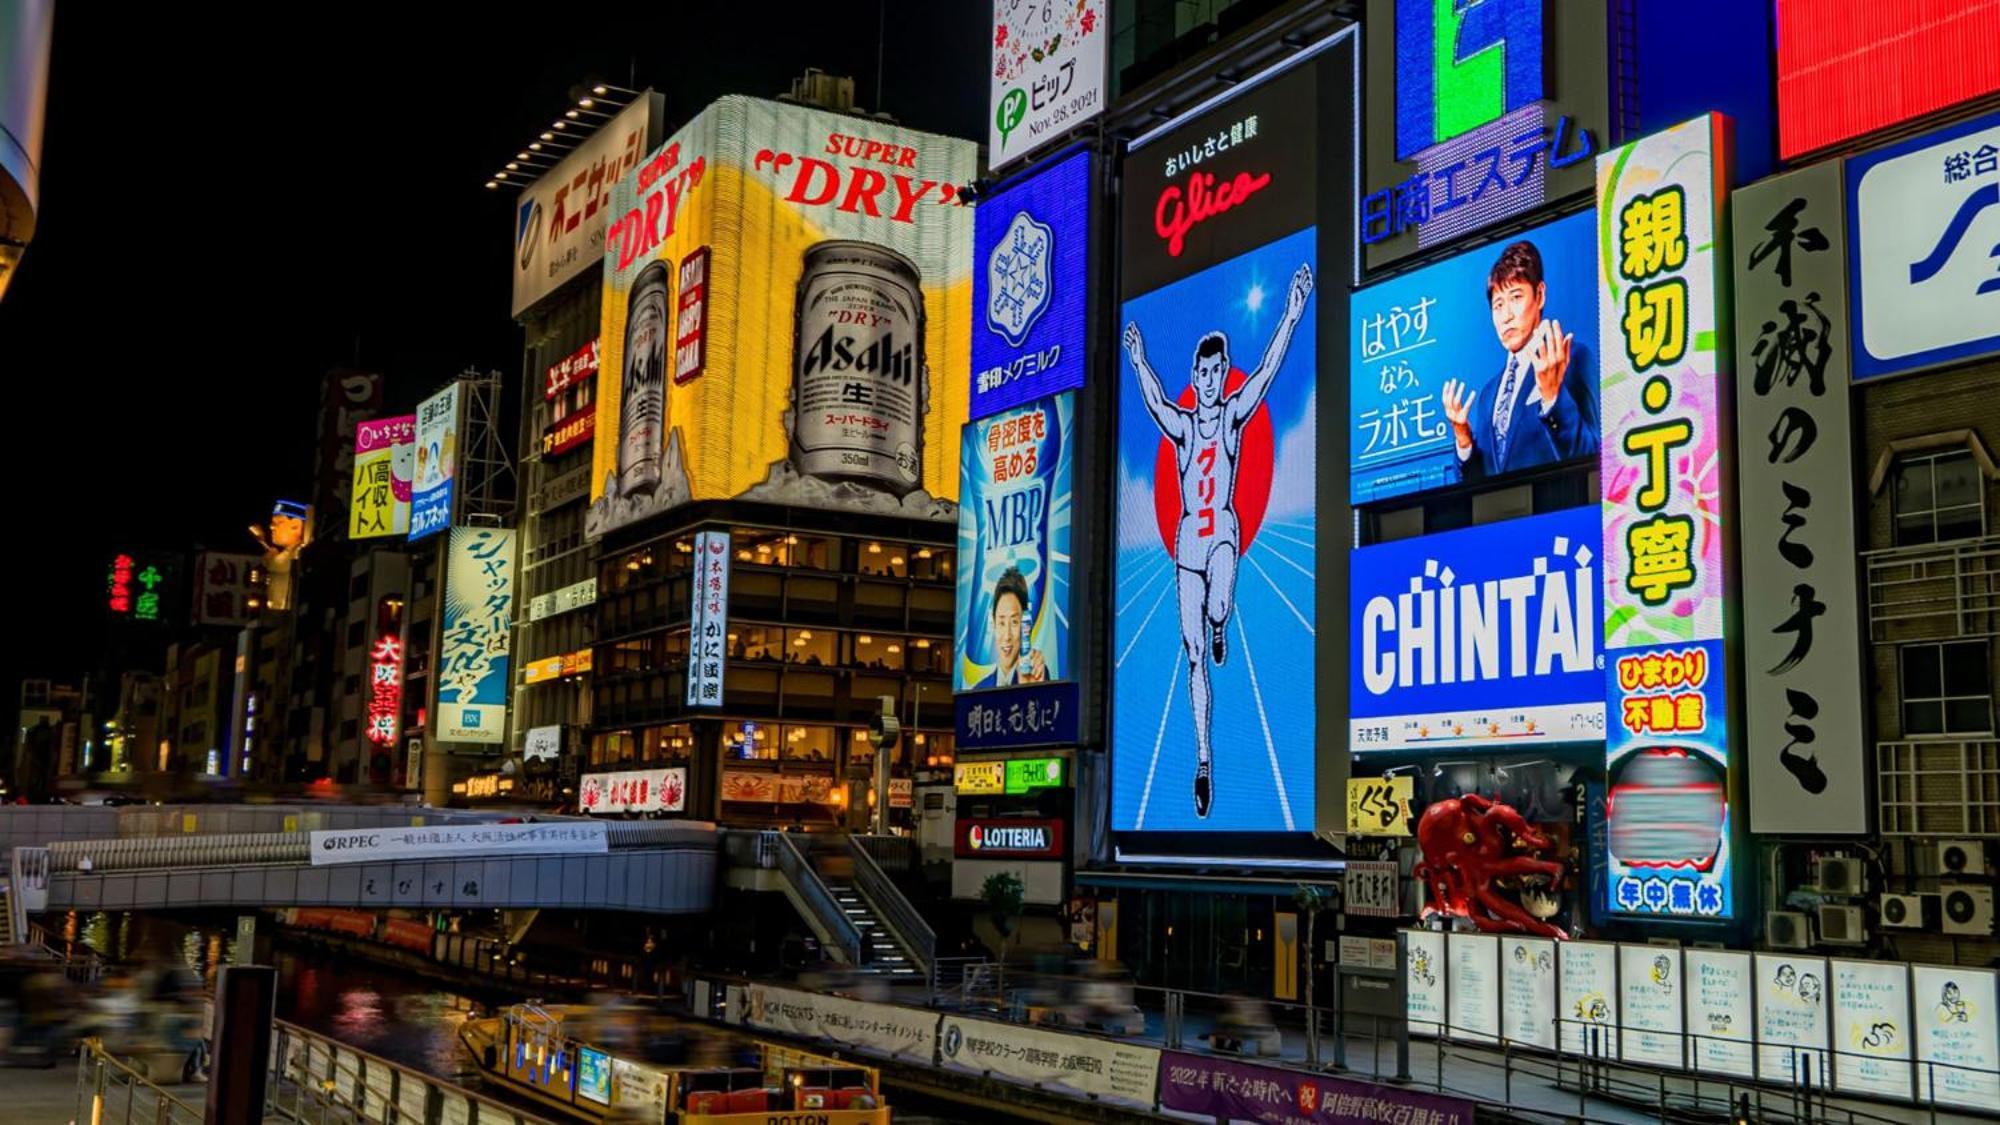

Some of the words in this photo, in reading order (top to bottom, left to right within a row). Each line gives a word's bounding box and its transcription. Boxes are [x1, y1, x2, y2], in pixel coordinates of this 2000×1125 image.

[1032, 57, 1077, 111] ピップ
[1071, 87, 1098, 114] 2021
[825, 132, 918, 169] SUPER
[1165, 115, 1259, 178] おいしさと健康
[1943, 144, 1999, 184] 総合
[1362, 115, 1593, 245] 日商エステム
[1155, 171, 1272, 257] Glico
[1362, 296, 1437, 359] はやす
[803, 324, 912, 387] Asahi
[978, 344, 1061, 393] 雪印メグミルク
[1379, 360, 1420, 394] なら、
[843, 383, 873, 406] 生
[1621, 183, 1693, 605] 親切・丁寧
[825, 414, 891, 432] スーパードライ
[988, 411, 1045, 453] 骨密度を
[1358, 393, 1448, 453] ラボモ。
[993, 446, 1038, 484] 高める
[1197, 440, 1217, 538] グリコ
[354, 462, 373, 534] バイト
[372, 459, 391, 532] 高収入
[986, 485, 1043, 550] MBP
[1748, 198, 1832, 796] 不滅のミナミ
[1362, 536, 1595, 696] CHINTAI
[702, 620, 722, 700] かに道楽
[1616, 649, 1708, 691] ひまわり
[1357, 726, 1389, 743] 天気予報
[1622, 693, 1706, 734] 不動産
[1359, 785, 1400, 828] くくる
[983, 827, 1045, 848] LOTTERIA
[1617, 877, 1723, 915] 年中無休
[1170, 1065, 1209, 1089] 2022年
[1211, 1072, 1293, 1104] 新たな時代へ
[1301, 1085, 1315, 1109] 祝
